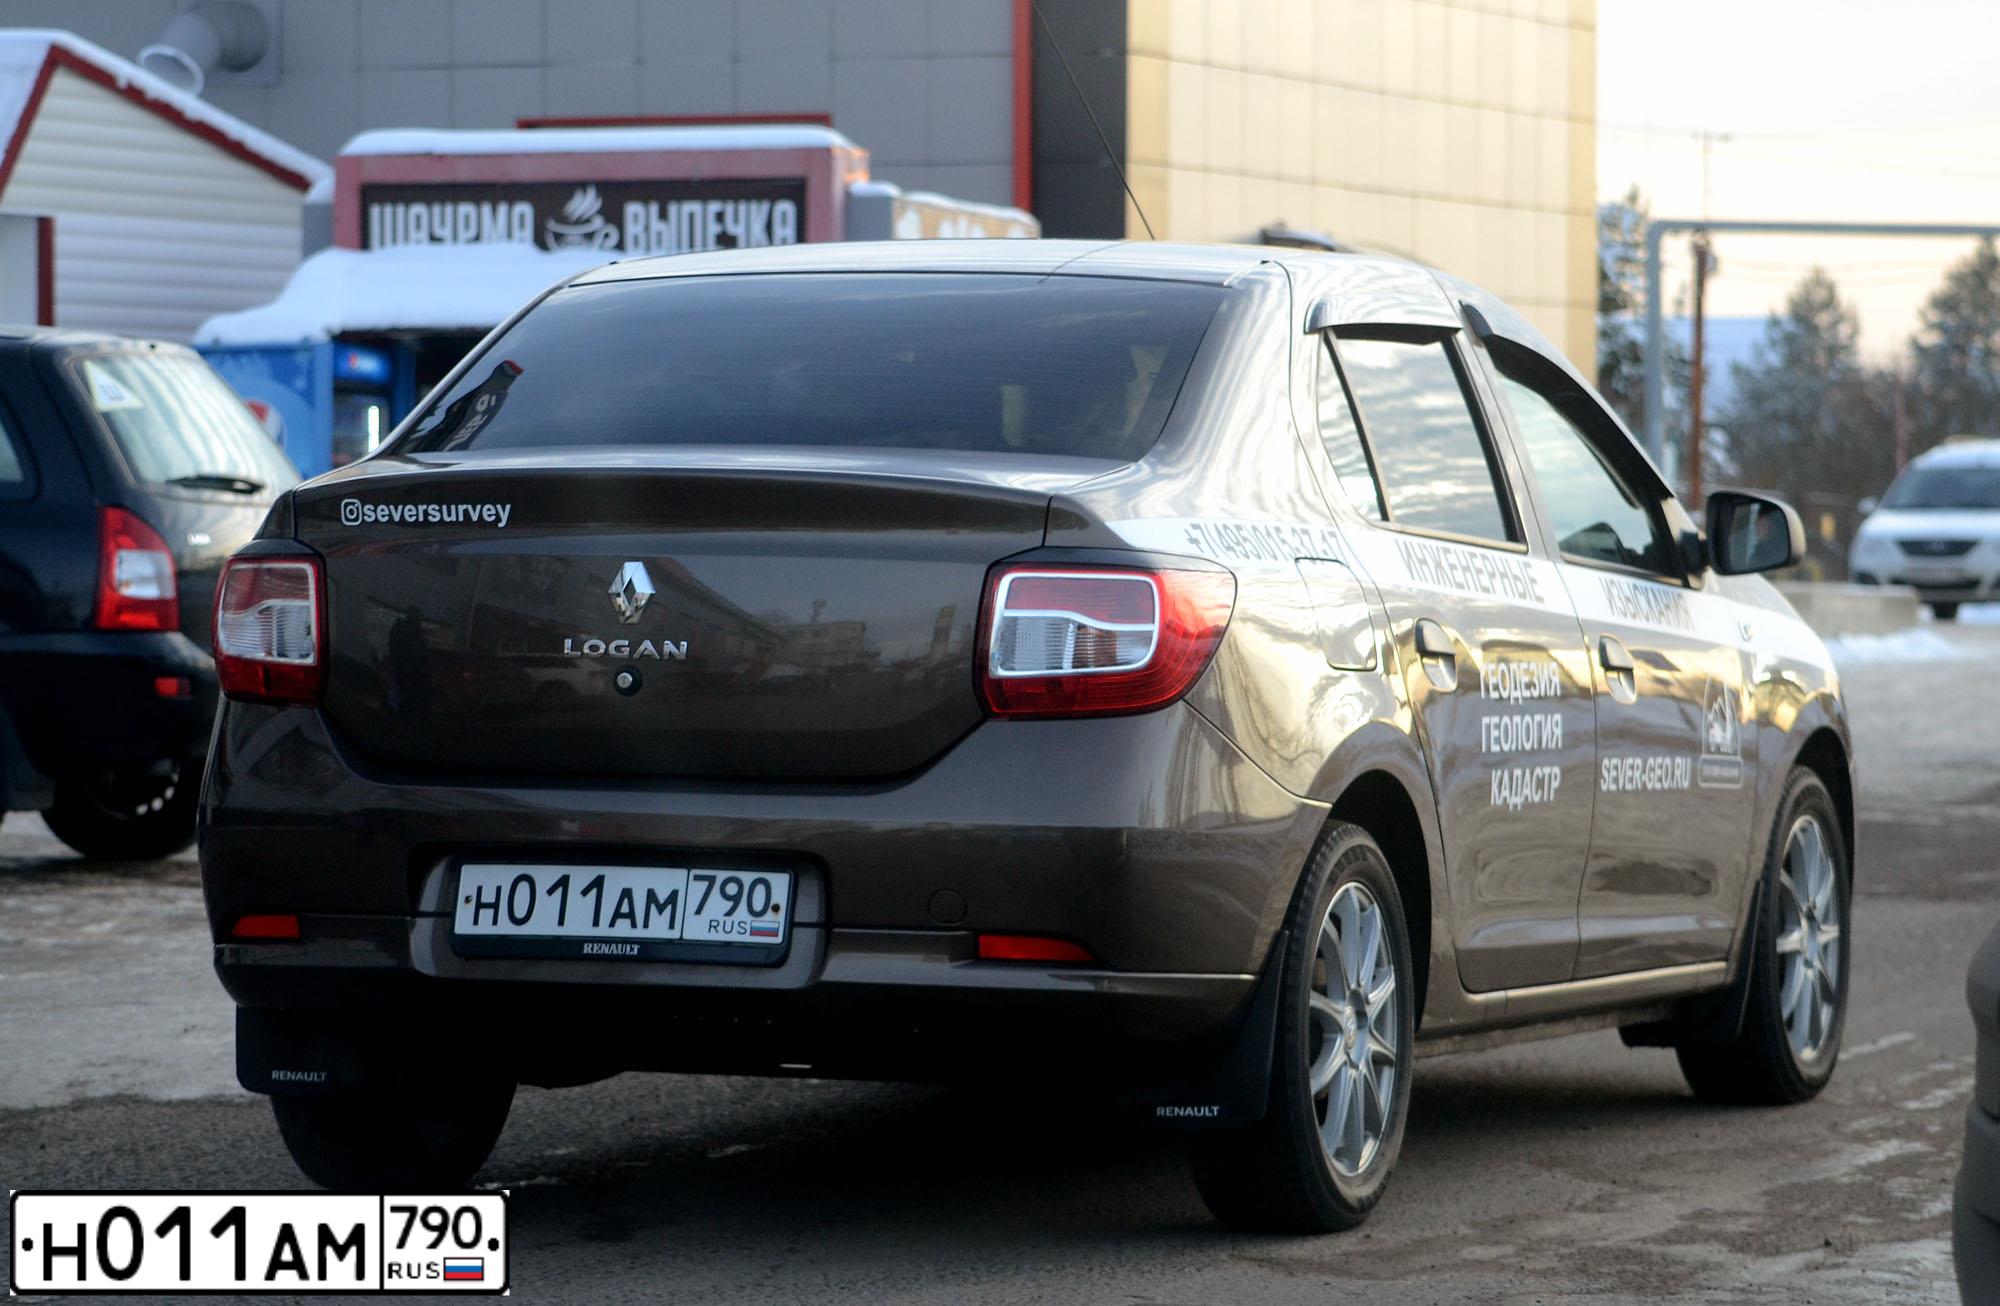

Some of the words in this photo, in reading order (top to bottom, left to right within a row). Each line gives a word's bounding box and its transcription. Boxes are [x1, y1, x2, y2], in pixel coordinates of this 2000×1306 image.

[368, 201, 535, 248] ШАУРМА
[623, 200, 798, 253] ВЫПЕЧКА
[363, 503, 511, 527] seversurvey
[1394, 538, 1545, 604] ИНЖЕНЕРНЫЕ
[1600, 576, 1696, 632] ИЗЫСКАНИЯ
[563, 638, 689, 661] LOGAN
[1480, 661, 1561, 705] ГЕОДЕЗИЯ
[1481, 713, 1563, 753] ГЕОЛОГИЯ
[1490, 766, 1561, 811] КАДАСТР
[1600, 756, 1690, 792] SEVER-GEO.RU
[692, 874, 773, 918] 790
[707, 919, 748, 936] RUS
[582, 942, 641, 956] RENAULT
[271, 1069, 328, 1083] RENAULT
[1156, 1105, 1220, 1118] RENAULT
